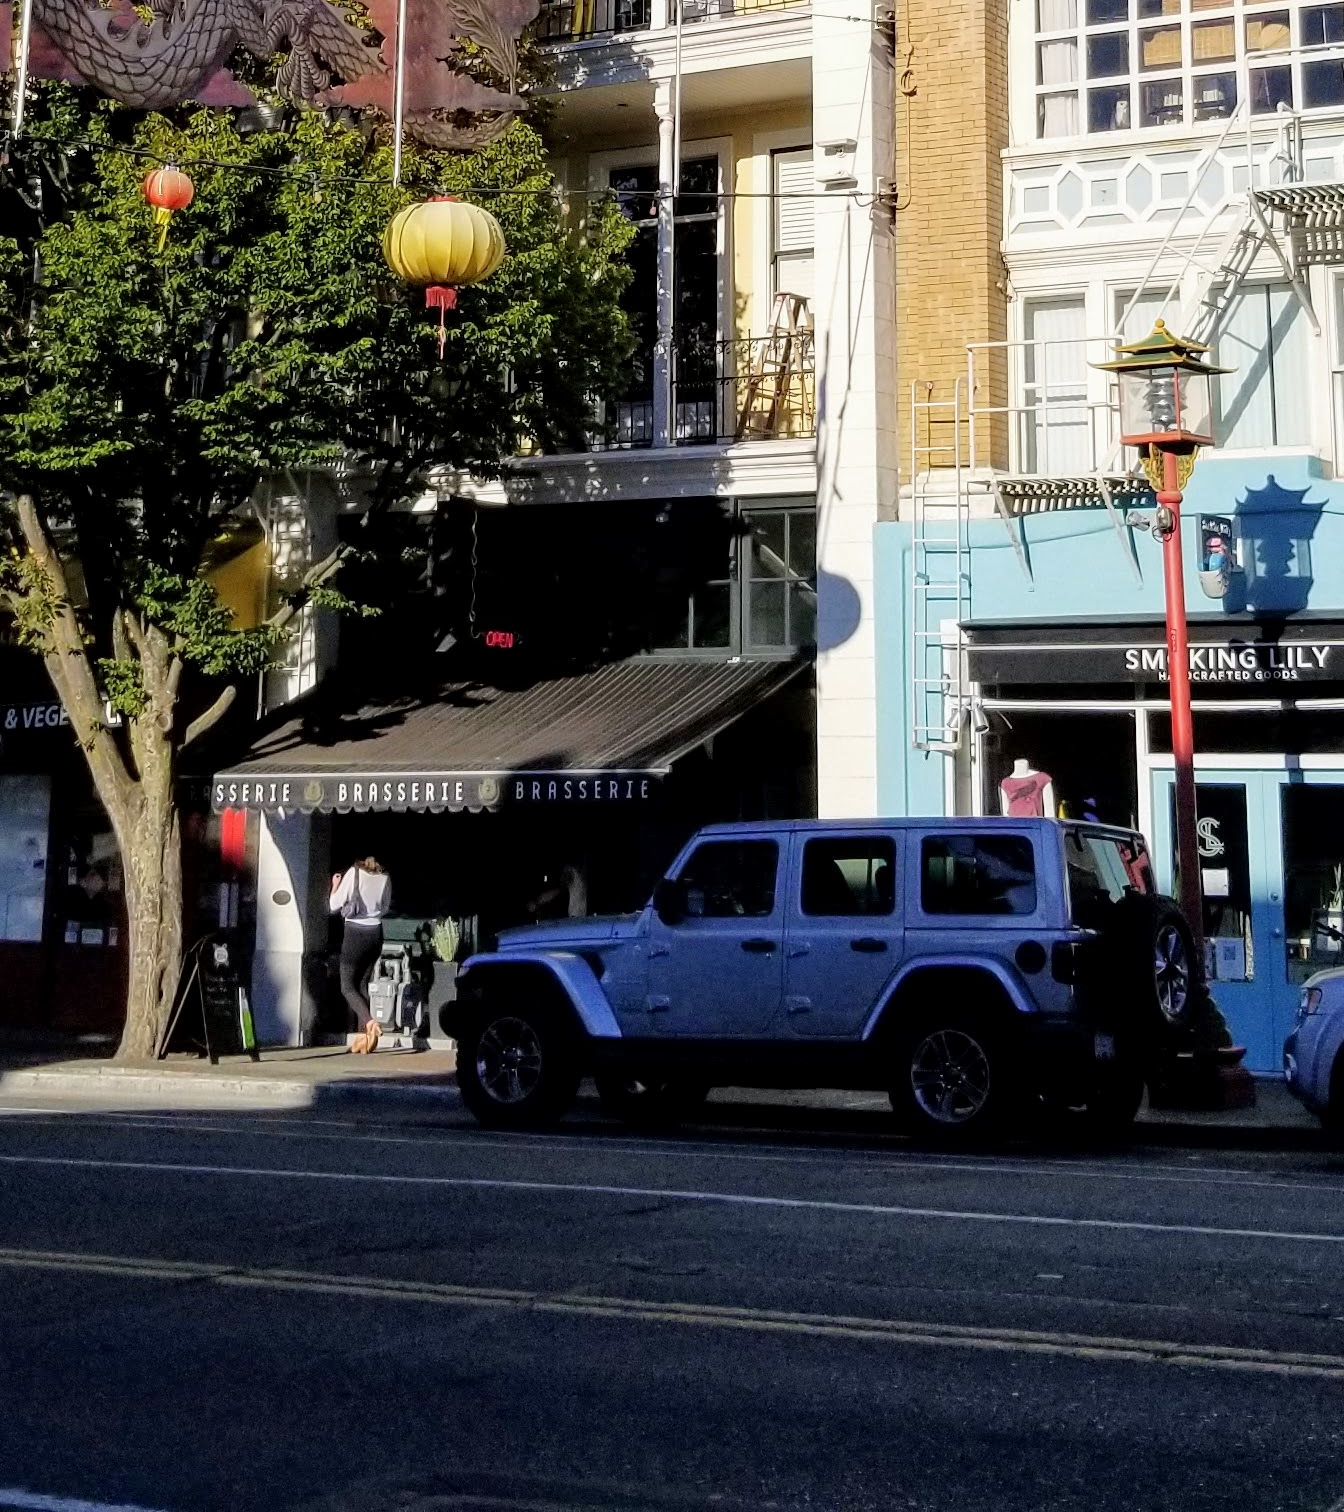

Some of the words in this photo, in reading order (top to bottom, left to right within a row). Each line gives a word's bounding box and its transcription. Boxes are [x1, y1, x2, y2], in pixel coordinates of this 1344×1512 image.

[1124, 647, 1256, 670] SMKING
[1268, 645, 1331, 669] LILY
[1158, 670, 1250, 681] HCRAFTED
[1254, 669, 1298, 680] GOODS
[4, 708, 18, 730] &
[22, 704, 71, 728] VEGE
[338, 781, 464, 803] BRASSERIE
[515, 779, 650, 801] BRASSERIE
